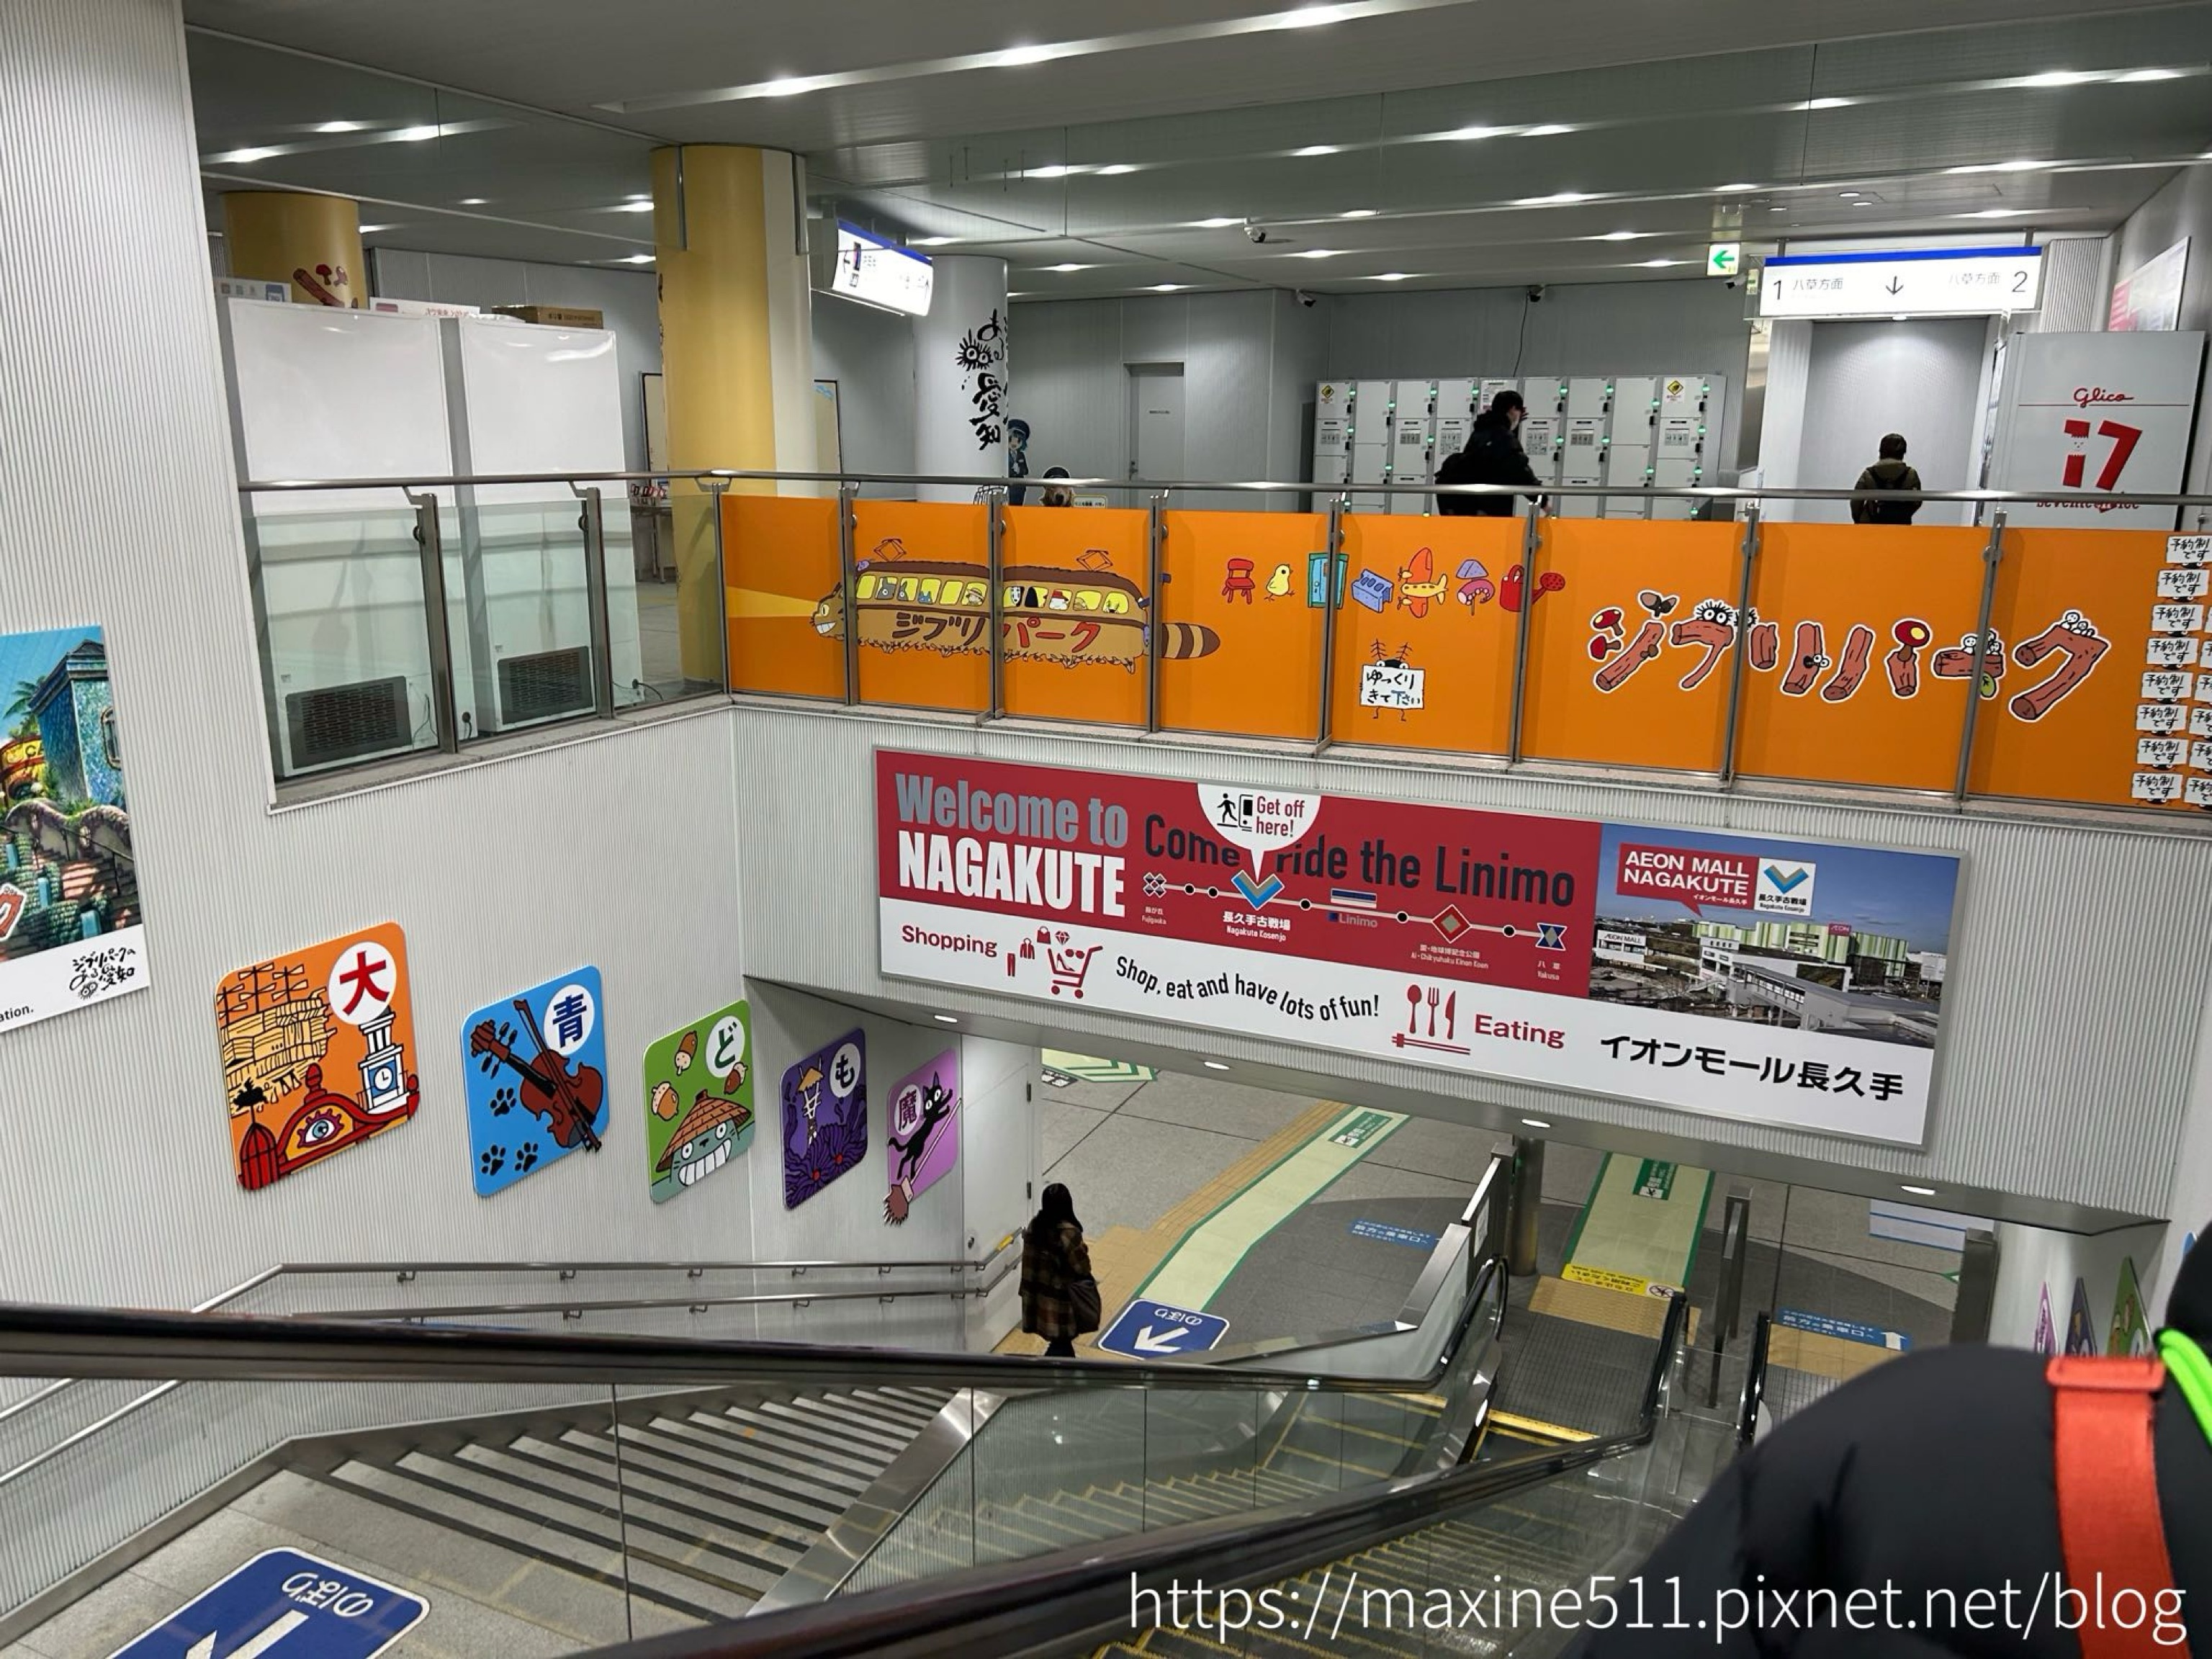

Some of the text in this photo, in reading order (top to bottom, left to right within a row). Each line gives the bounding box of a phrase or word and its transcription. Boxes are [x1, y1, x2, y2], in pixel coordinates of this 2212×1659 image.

[1793, 276, 1843, 291] 八草方面
[1948, 271, 2001, 287] 八草方面
[2011, 270, 2029, 293] 2
[1773, 279, 1782, 300] 1
[2073, 387, 2134, 408] Glico
[2170, 538, 2211, 551] 予約制
[2183, 550, 2211, 561] です
[2161, 572, 2201, 585] 予約制
[2174, 584, 2200, 595] です
[2155, 607, 2195, 619] 予約制
[2168, 619, 2195, 629] です
[2151, 640, 2190, 653] 予約制
[2164, 652, 2190, 662] です
[1366, 670, 1415, 689] ゆっくり
[2145, 674, 2184, 687] 予約制
[1367, 688, 1421, 706] きて下さい
[2158, 686, 2184, 697] です
[2139, 706, 2179, 719] 予約制
[2152, 719, 2179, 729] です
[2141, 740, 2180, 752] 予約制
[2153, 752, 2180, 763] です
[2135, 775, 2175, 787] 予約制
[2148, 786, 2174, 797] です
[896, 773, 1128, 848] Welcome to
[1256, 796, 1305, 818] Get off
[1256, 817, 1294, 837] here!
[1145, 814, 1575, 907] Come ride the Linimo
[1625, 851, 1750, 878] AEON MALL
[898, 830, 1125, 918] NAGAKUTE
[1623, 868, 1748, 896] NAGAKUTE
[1223, 911, 1291, 931] 長久手古戦場
[1338, 913, 1378, 928] Linimo
[902, 925, 998, 958] Shopping
[1226, 925, 1287, 943] Nagakute Kosenjo
[339, 950, 390, 1016] 大
[1115, 956, 1380, 1022] Shop, eat and have lots of fun!
[552, 994, 588, 1048] 青
[1474, 1014, 1565, 1049] Eating
[714, 1021, 741, 1068] ど
[833, 1052, 854, 1085] も
[1600, 1035, 1904, 1102] イオンモール長久手
[896, 1089, 921, 1131] 魔
[282, 1572, 374, 1618] のぼり
